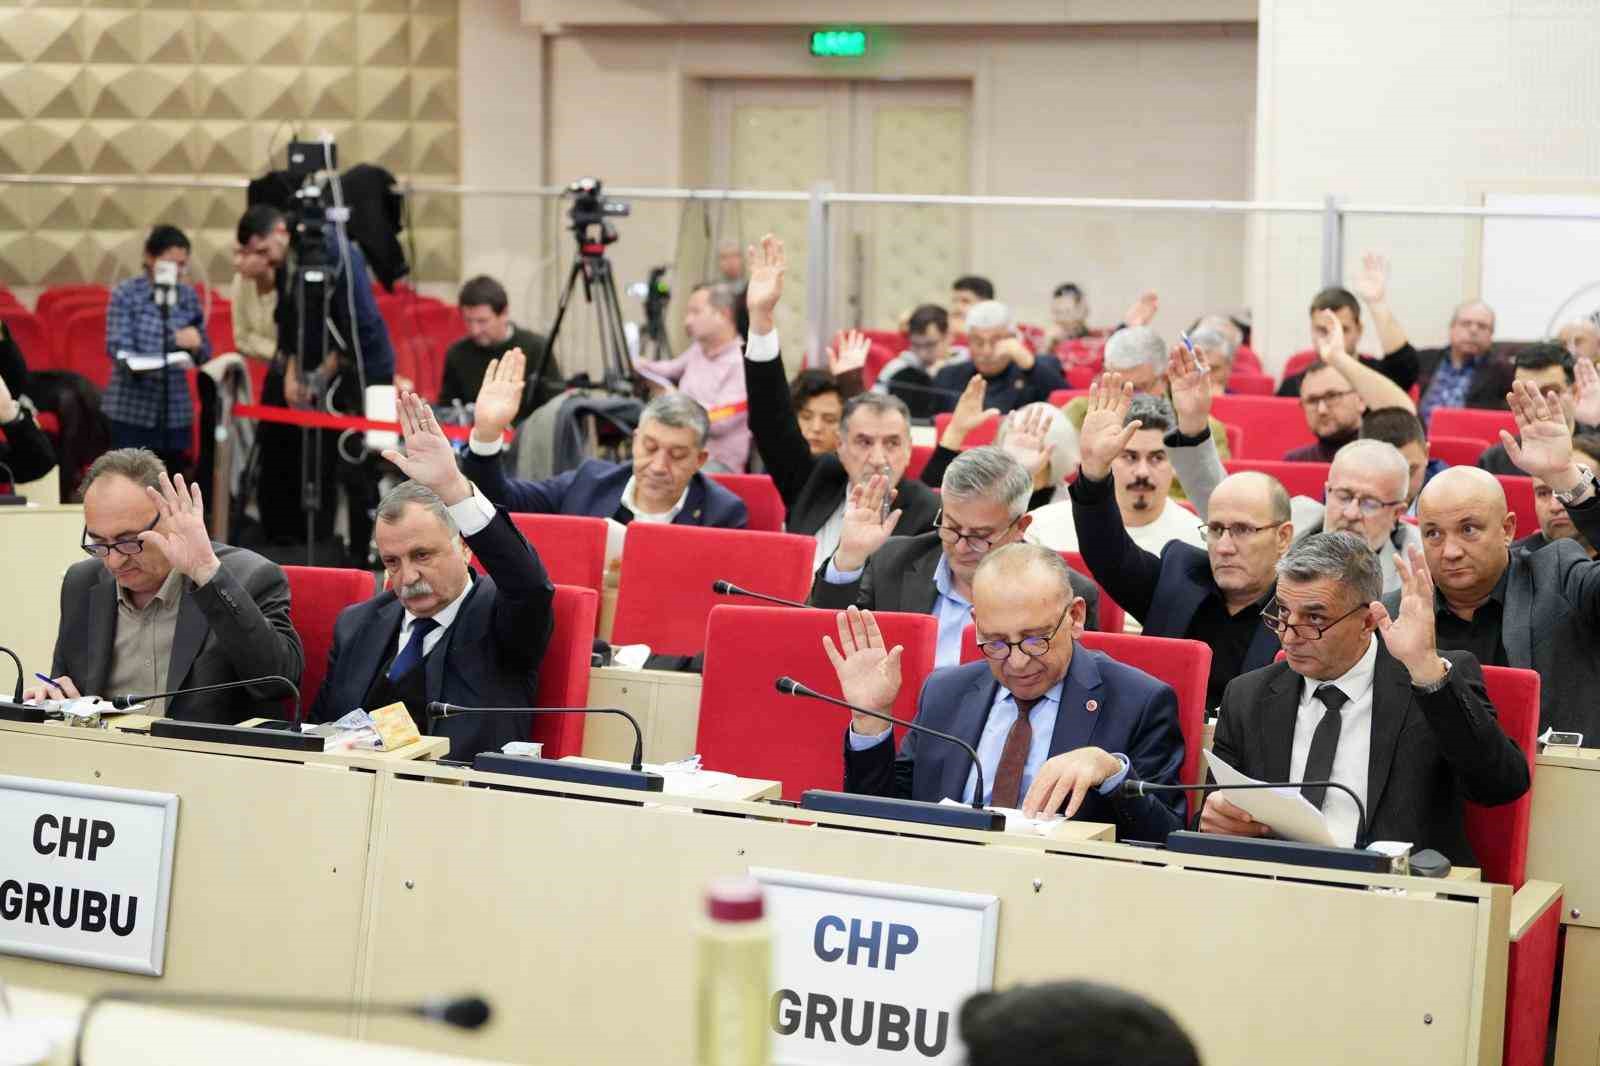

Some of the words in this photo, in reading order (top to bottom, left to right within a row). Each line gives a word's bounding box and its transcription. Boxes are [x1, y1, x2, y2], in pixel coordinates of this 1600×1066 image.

[33, 813, 115, 861] CHP
[0, 879, 138, 936] GRUBU
[813, 915, 919, 971] CHP
[771, 989, 949, 1057] GRUBU
